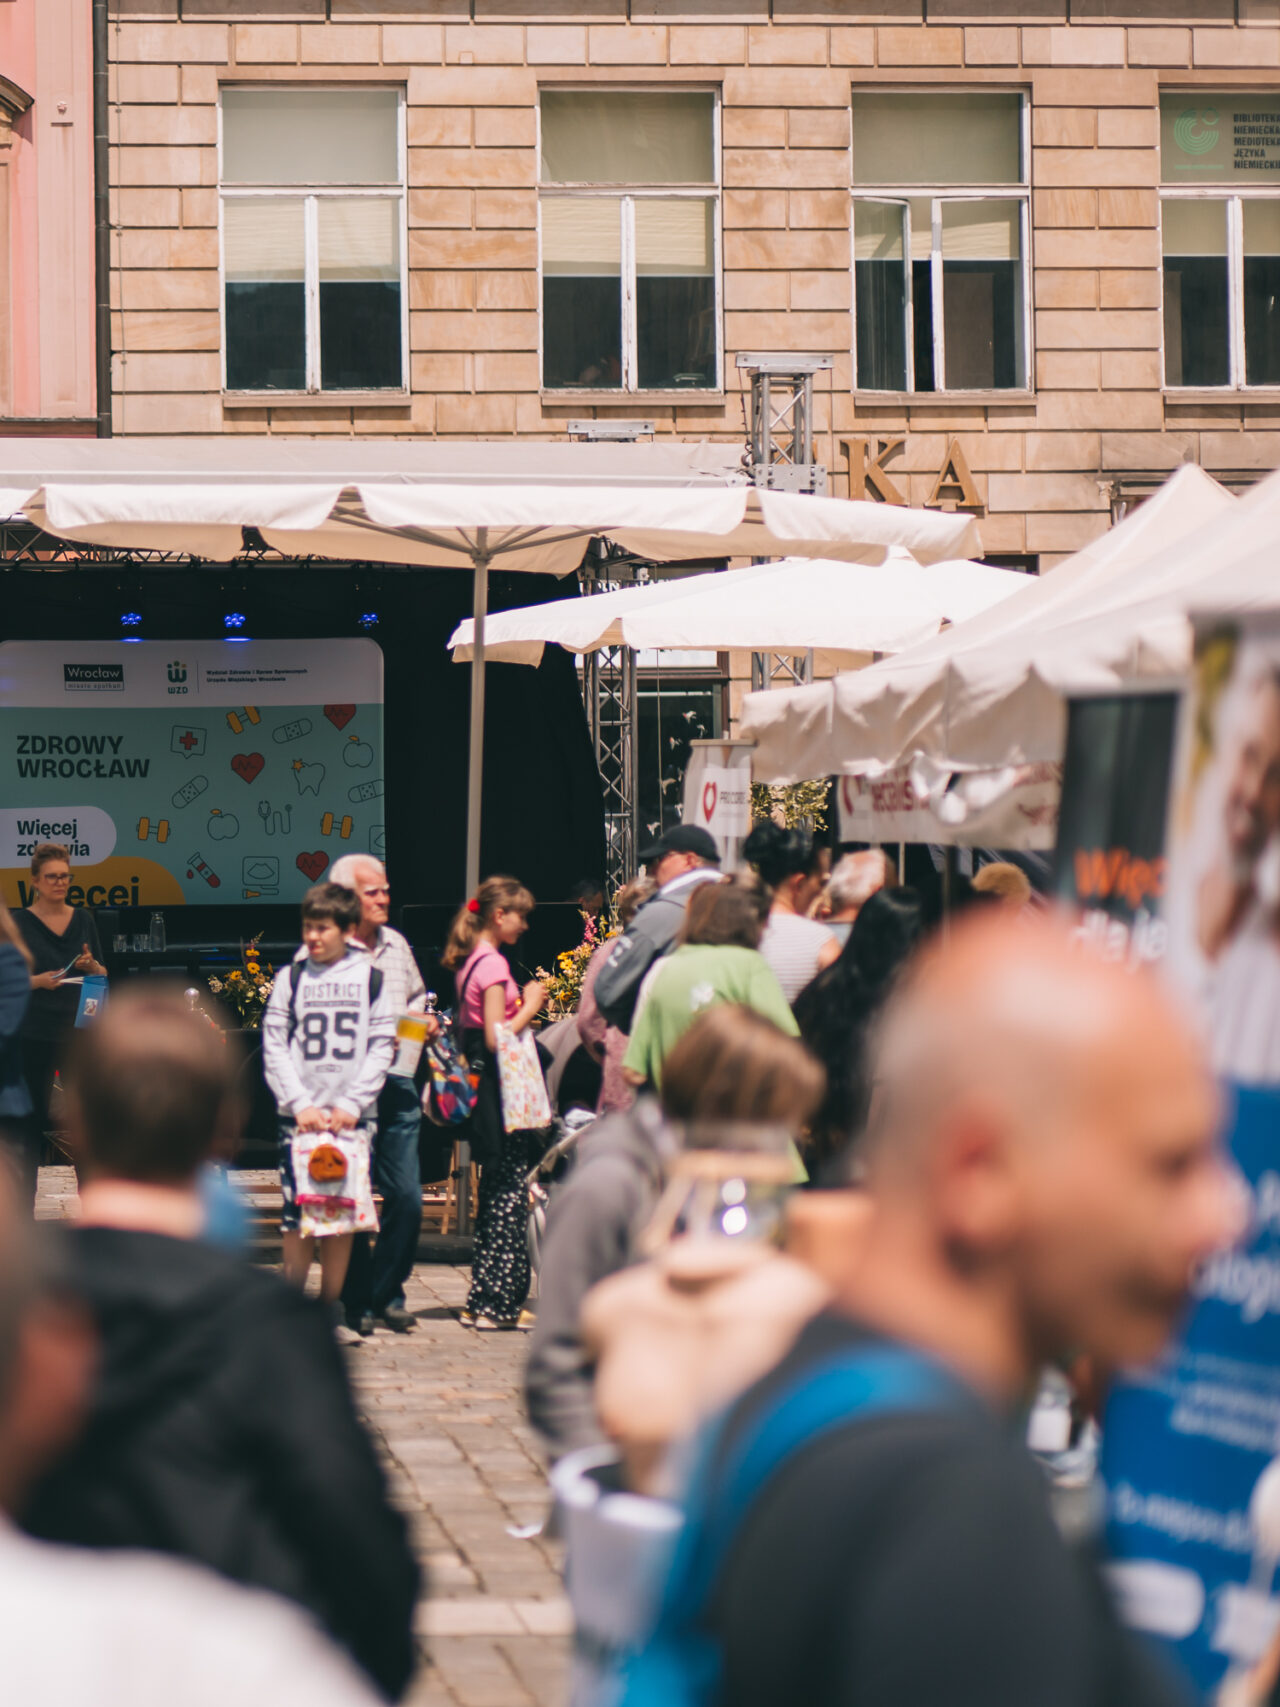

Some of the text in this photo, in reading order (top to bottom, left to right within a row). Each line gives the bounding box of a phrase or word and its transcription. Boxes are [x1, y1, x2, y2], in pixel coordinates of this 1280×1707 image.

[67, 666, 121, 679] Wrocław
[16, 735, 124, 755] ZDROWY
[17, 758, 151, 779] WROCŁAW
[17, 818, 78, 840] Więcej
[303, 982, 362, 1000] DISTRICT
[302, 1011, 360, 1061] 85
